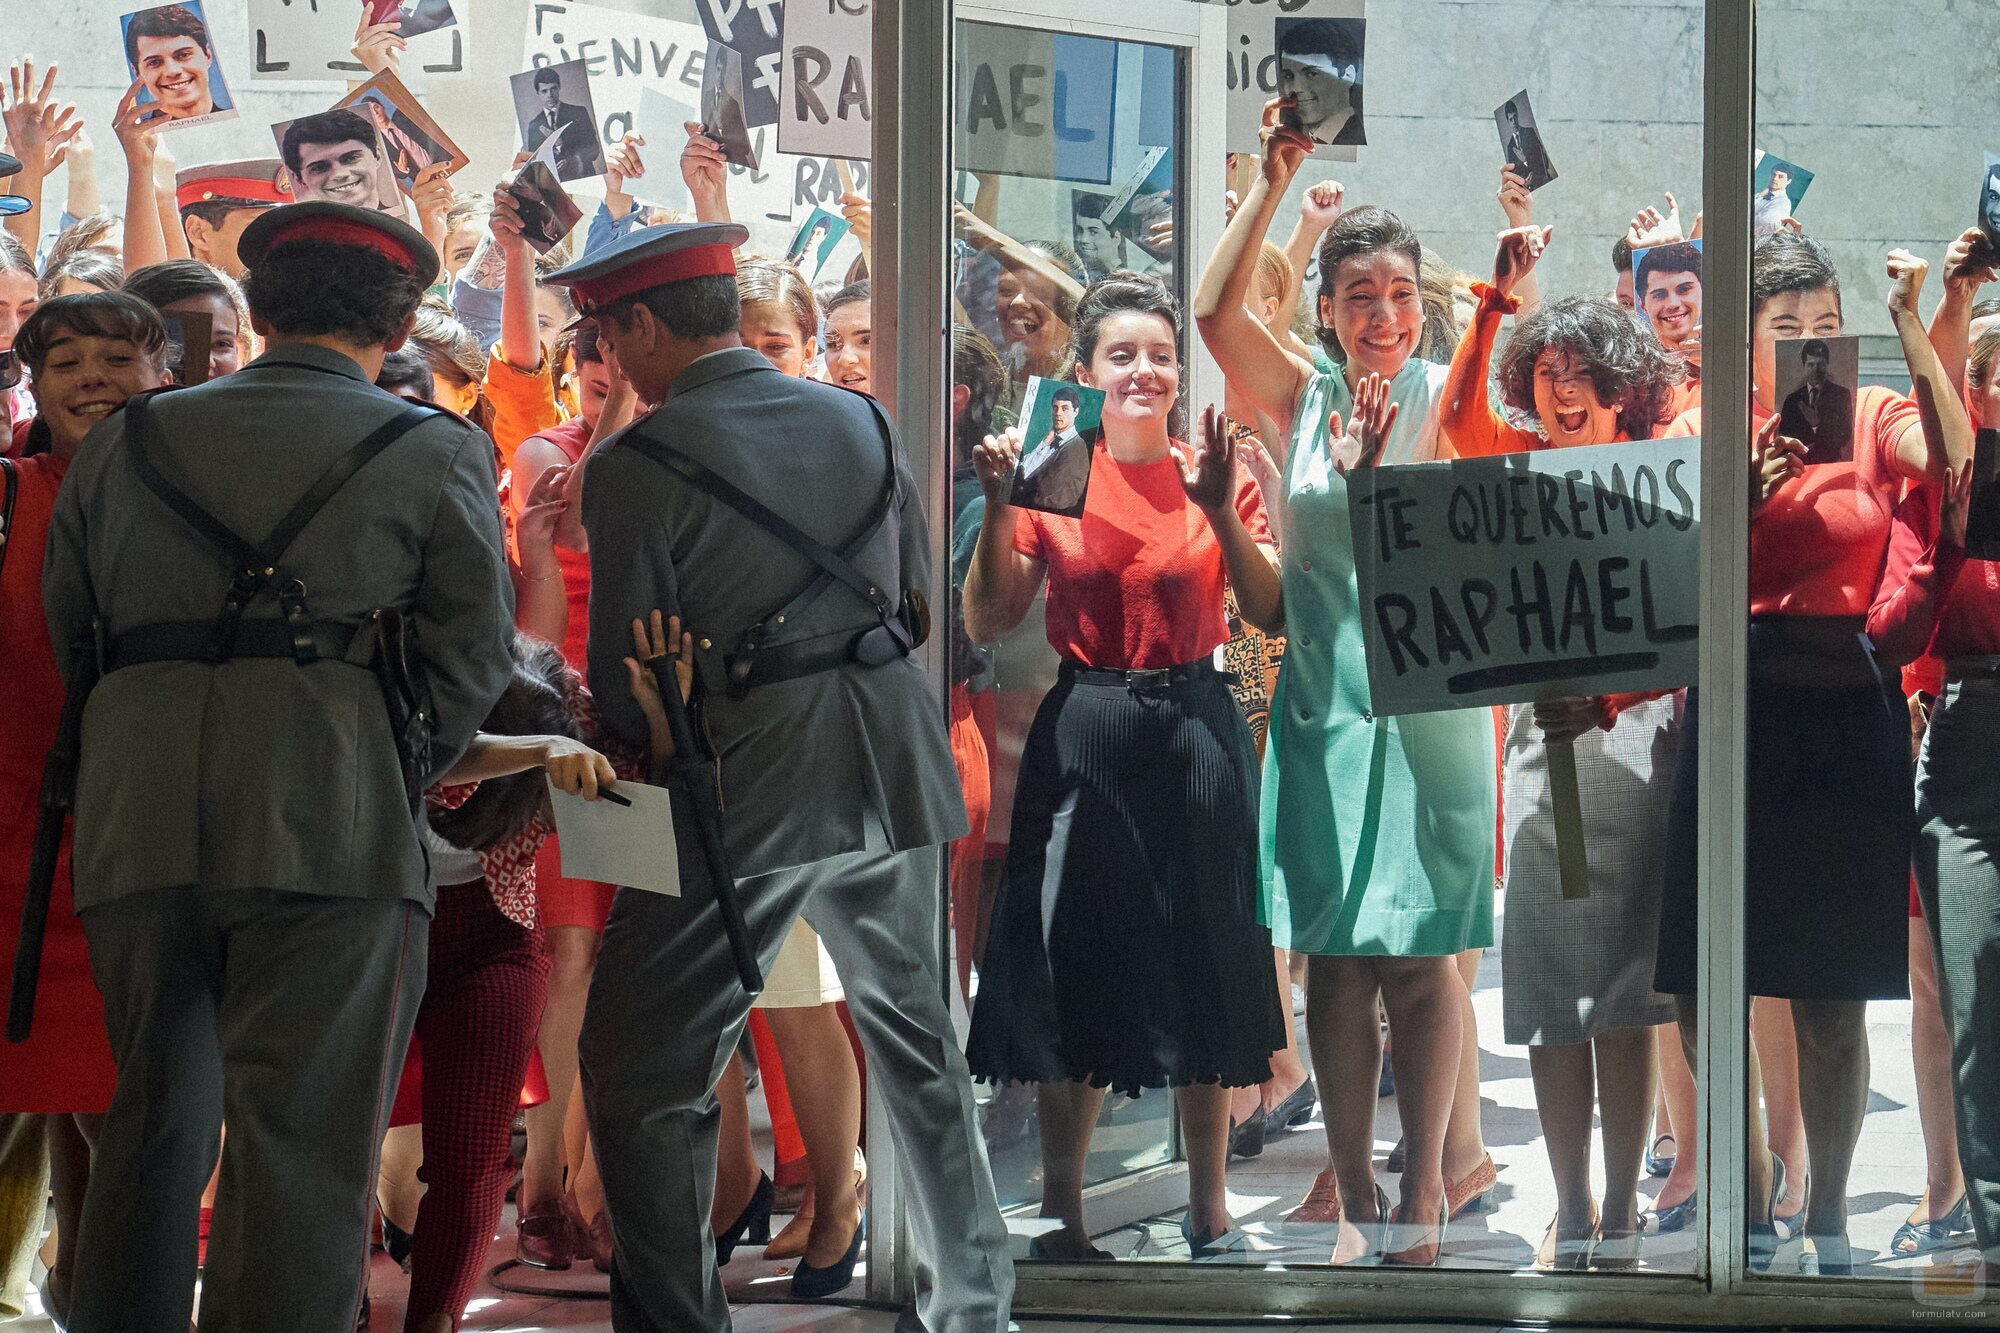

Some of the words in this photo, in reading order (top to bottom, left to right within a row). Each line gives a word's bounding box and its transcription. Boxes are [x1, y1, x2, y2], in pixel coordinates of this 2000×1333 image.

[168, 115, 214, 128] RAPHAEL
[955, 62, 1096, 143] AEL
[1360, 487, 1422, 562] TE
[1448, 458, 1694, 546] QUEREMOS
[1374, 557, 1699, 676] RAPHAEL
